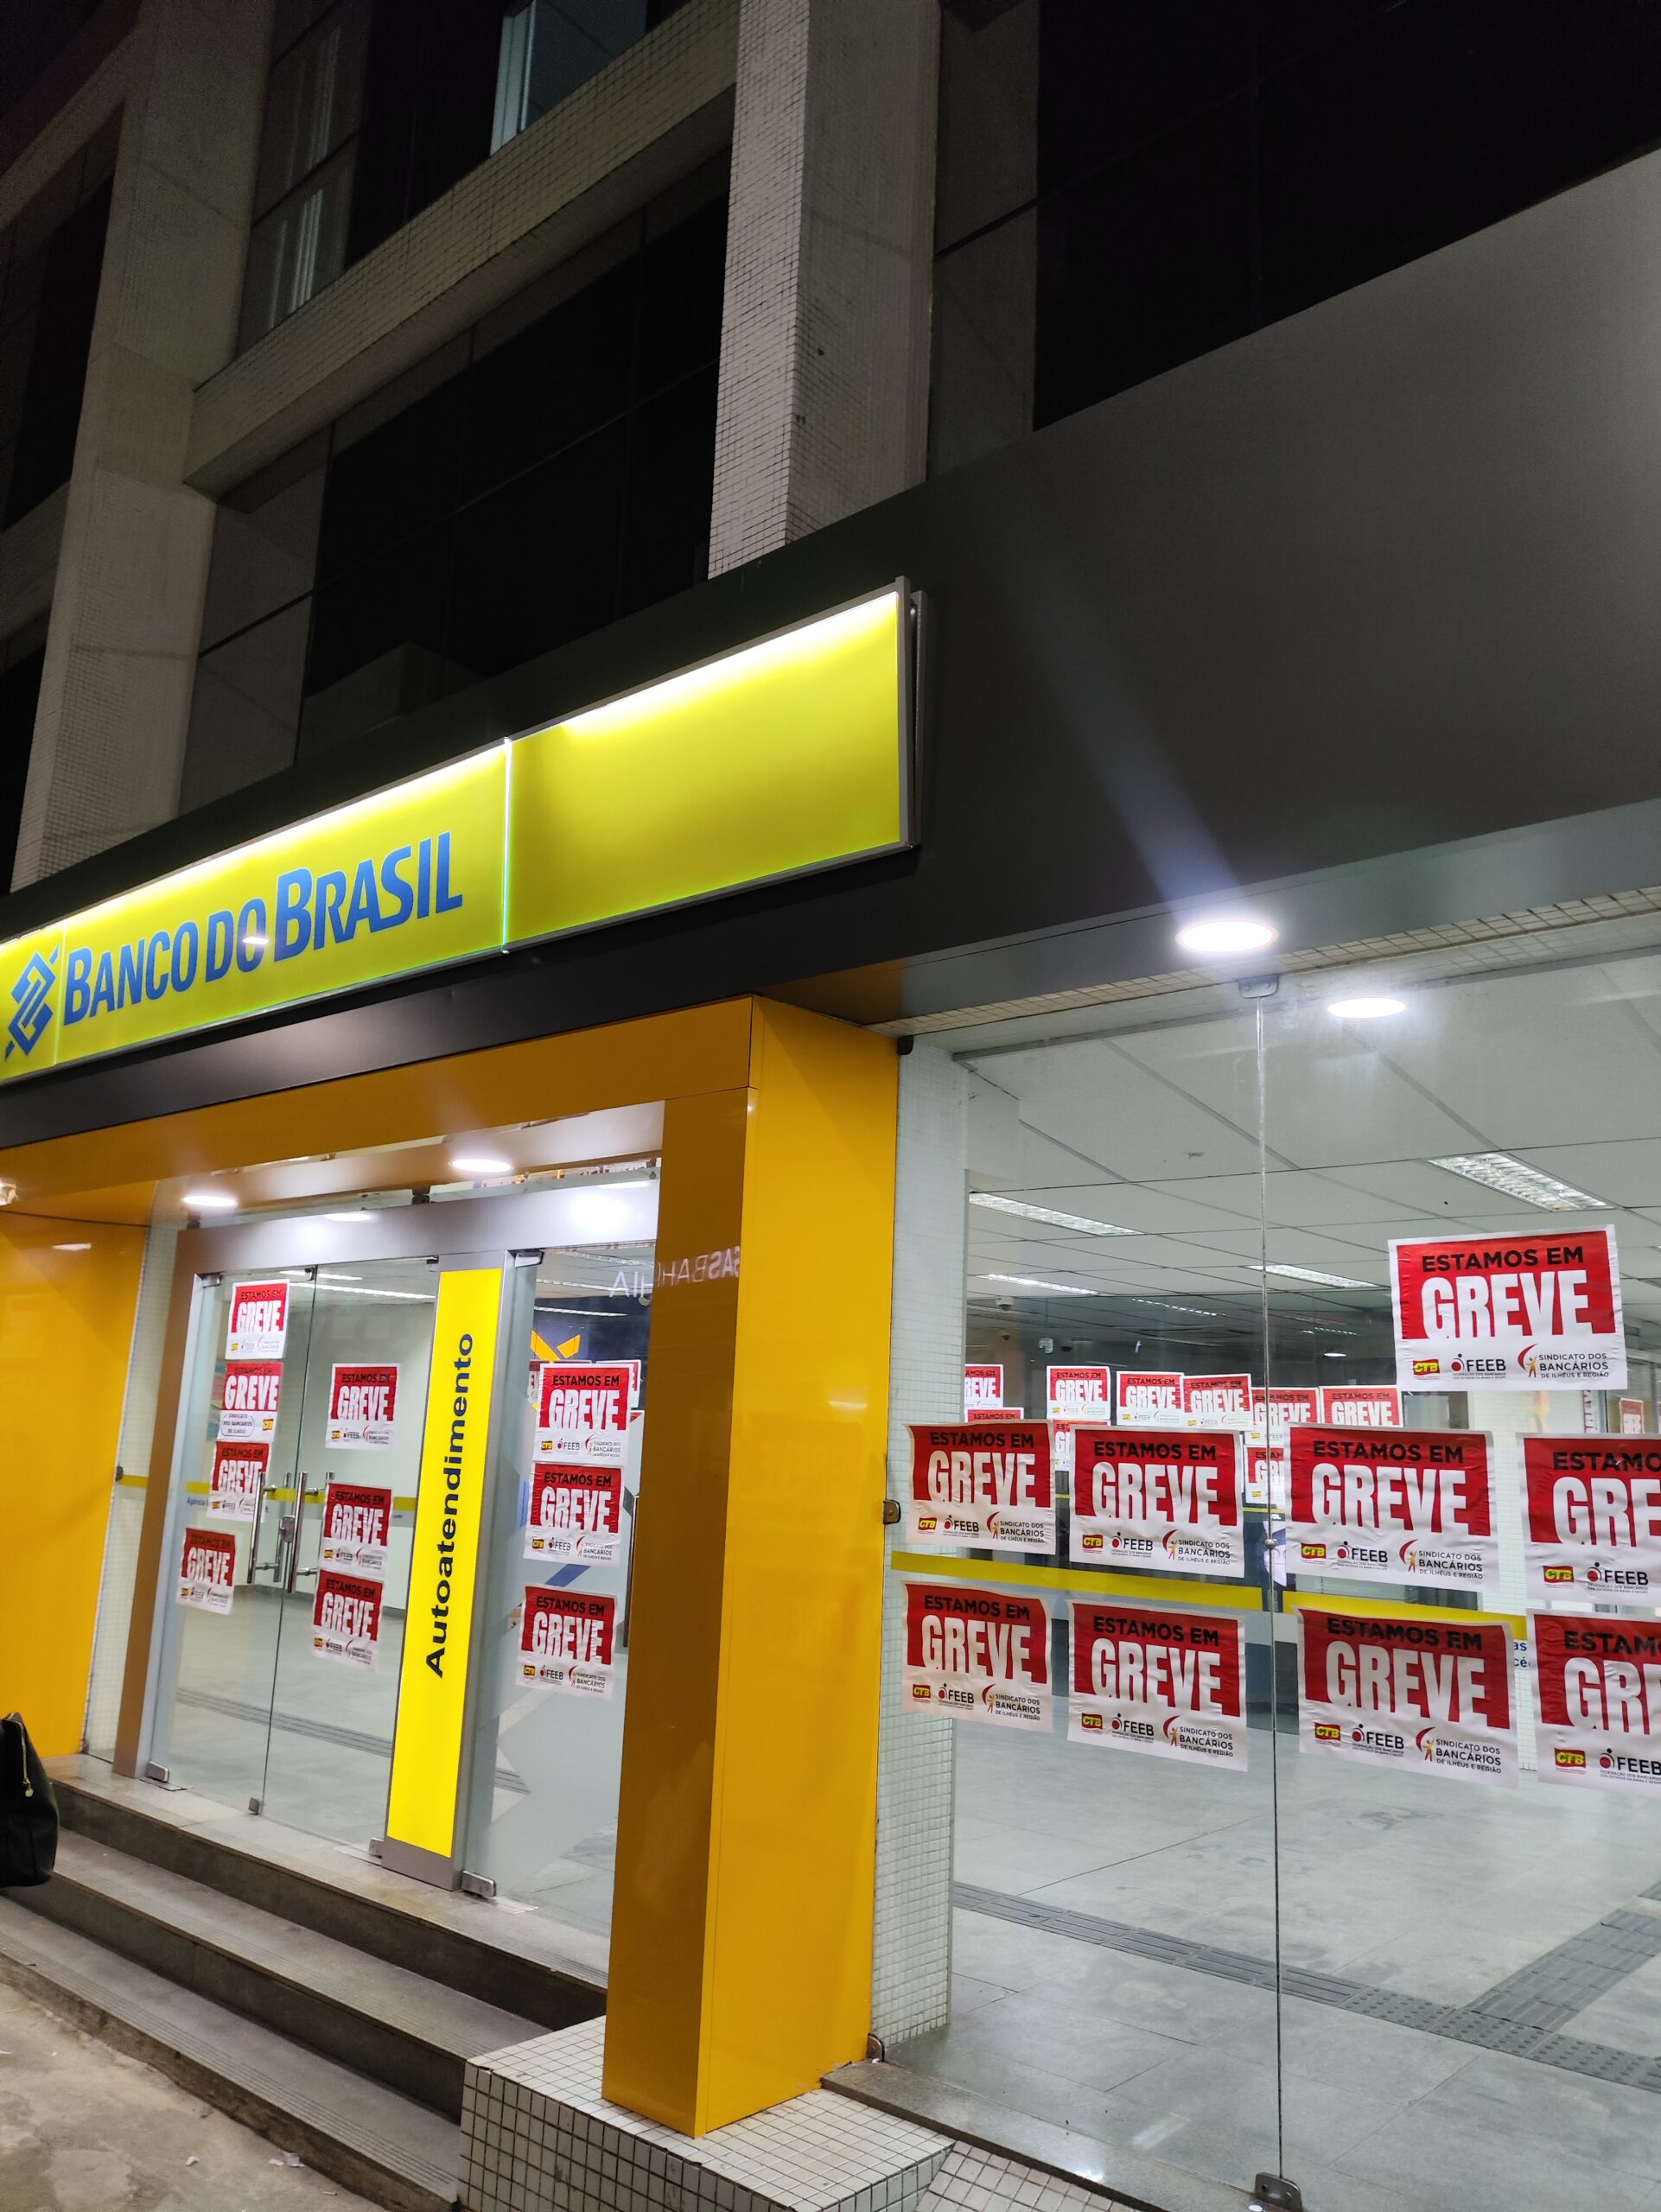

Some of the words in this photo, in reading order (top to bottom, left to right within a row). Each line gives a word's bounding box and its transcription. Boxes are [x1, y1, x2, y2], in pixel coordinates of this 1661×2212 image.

[64, 921, 199, 1026] BANCO
[206, 899, 266, 982] DO
[274, 832, 462, 962] BRASIL
[1422, 1249, 1538, 1272] ESTAMOS
[1547, 1246, 1583, 1265] EM
[1422, 1270, 1593, 1338] GREVE
[236, 1300, 282, 1332] GREVE
[1414, 1362, 1439, 1372] CTB
[1467, 1359, 1506, 1371] FEEB
[1540, 1361, 1608, 1370] BANCÁRIOS
[342, 1374, 377, 1382] ESTAMOS
[553, 1376, 601, 1386] ESTAMOS
[605, 1376, 619, 1386] EM
[225, 1375, 279, 1410] GREVE
[1055, 1380, 1103, 1401] GREVE
[1126, 1385, 1176, 1408] GREVE
[338, 1386, 389, 1420] GREVE
[549, 1389, 620, 1429] GREVE
[1190, 1389, 1244, 1413] GREVE
[1332, 1402, 1392, 1426] GREVE
[930, 1433, 1005, 1447] ESTAMOS
[1011, 1433, 1034, 1447] EM
[1094, 1441, 1181, 1459] ESTAMOS
[1189, 1445, 1216, 1460] EM
[1314, 1440, 1421, 1461] ESTAMOS
[1429, 1445, 1463, 1463] EM
[544, 1472, 592, 1485] ESTAMOS
[596, 1476, 611, 1486] EM
[928, 1451, 1036, 1506] GREVE
[336, 1491, 371, 1503] ESTAMOS
[1092, 1462, 1220, 1524] GREVE
[1312, 1463, 1469, 1535] GREVE
[426, 1334, 473, 1679] Autoatendimento
[540, 1486, 611, 1533] GREVE
[331, 1503, 384, 1545] GREVE
[954, 1521, 979, 1531] FEEB
[1084, 1536, 1102, 1547] CTB
[1123, 1538, 1153, 1551] FEEB
[1178, 1540, 1213, 1548] SINDICATO
[1178, 1546, 1230, 1559] BANCÁRIOS
[1302, 1546, 1326, 1556] CTB
[1352, 1548, 1387, 1562] FEEB
[1419, 1550, 1461, 1560] SINDICATO
[188, 1547, 230, 1586] GREVE
[1419, 1558, 1482, 1571] BANCÁRIOS
[1545, 1568, 1573, 1580] CTB
[1605, 1570, 1649, 1585] FEEB
[321, 1592, 374, 1637] GREVE
[537, 1596, 585, 1613] ESTAMOS
[589, 1604, 604, 1616] EM
[925, 1595, 1001, 1617] ESTAMOS
[1006, 1604, 1029, 1620] EM
[532, 1611, 604, 1664] GREVE
[1093, 1616, 1183, 1642] ESTAMOS
[1191, 1628, 1219, 1646] EM
[1327, 1618, 1439, 1646] ESTAMOS
[1448, 1630, 1482, 1651] EM
[922, 1615, 1032, 1682] GREVE
[1564, 1630, 1661, 1656] ESTAM
[1091, 1638, 1222, 1716] GREVE
[1327, 1641, 1487, 1726] GREVE
[914, 1687, 930, 1696] CTB
[949, 1690, 974, 1703] FEEB
[1083, 1716, 1102, 1726] CTB
[1124, 1720, 1154, 1736] FEEB
[1180, 1727, 1216, 1738] SINDICATO
[1316, 1726, 1340, 1738] CTB
[1367, 1732, 1403, 1749] FEEB
[1180, 1735, 1232, 1750] BANCÁRIOS
[1435, 1738, 1480, 1751] SINDICATO
[1436, 1749, 1501, 1765] BANCÁRIOS
[1556, 1752, 1585, 1764] CTB
[1617, 1757, 1661, 1775] FEEB
